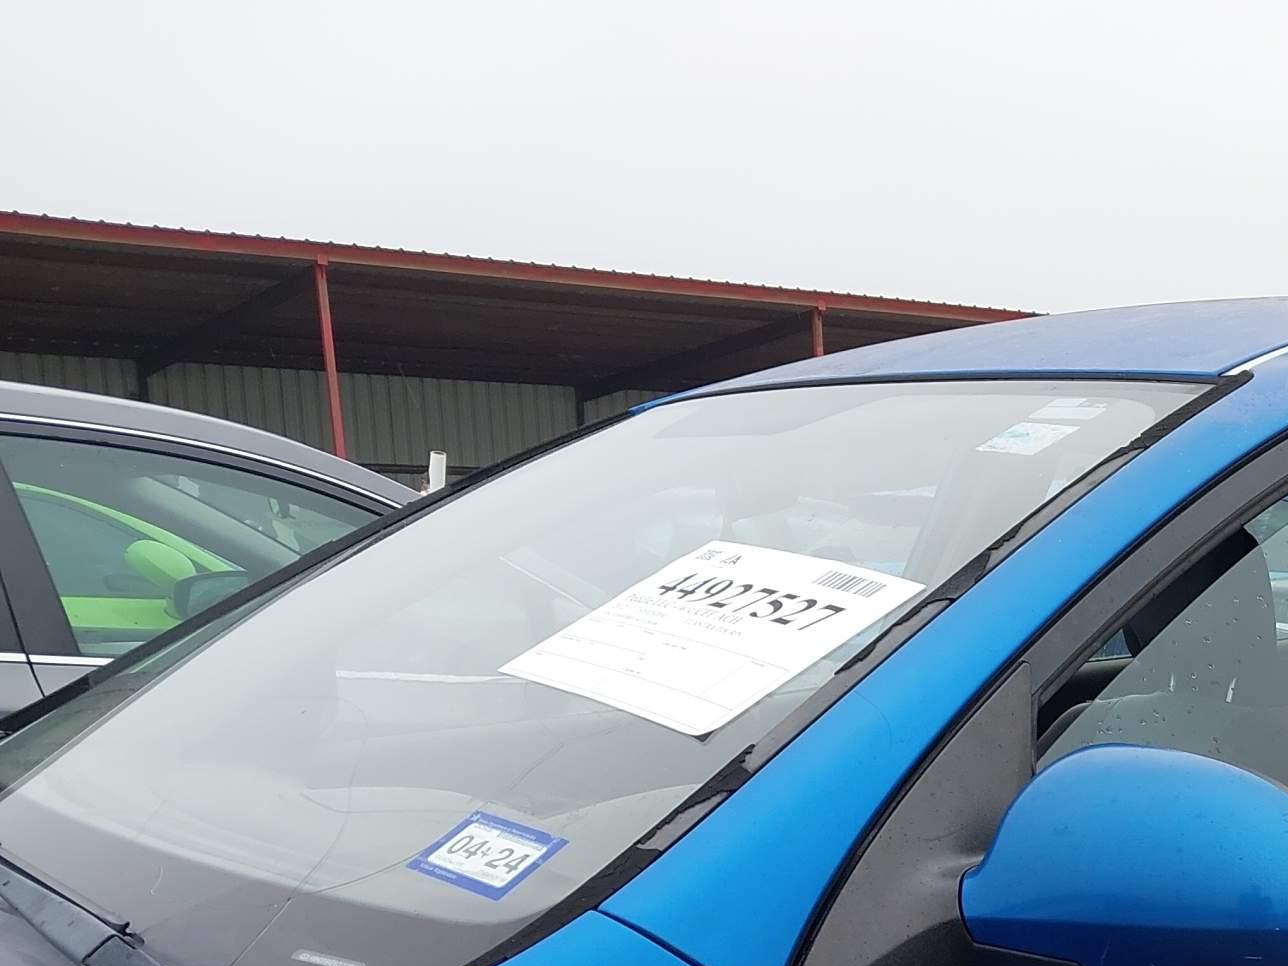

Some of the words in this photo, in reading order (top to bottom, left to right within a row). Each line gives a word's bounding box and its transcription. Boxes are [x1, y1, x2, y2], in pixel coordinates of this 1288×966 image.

[658, 573, 847, 631] 44927527
[447, 835, 489, 860] 04
[484, 847, 530, 874] 24
